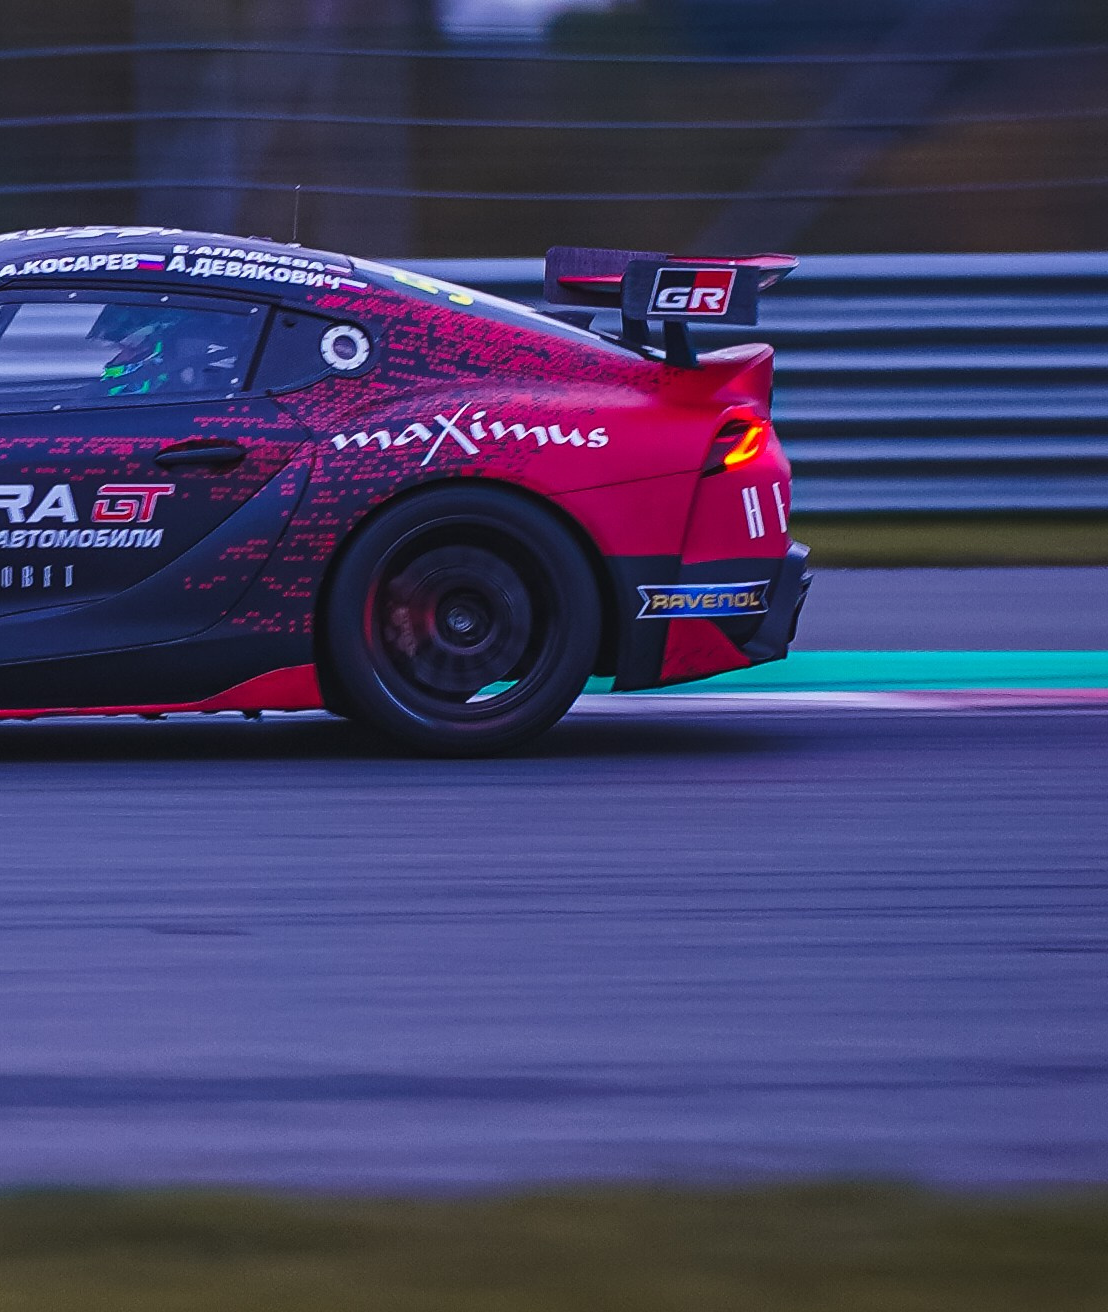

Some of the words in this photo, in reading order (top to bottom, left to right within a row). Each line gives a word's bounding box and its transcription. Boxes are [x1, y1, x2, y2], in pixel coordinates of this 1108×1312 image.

[165, 255, 342, 290] А.ДЕВЯКОВИЧ
[655, 287, 728, 311] GR
[91, 483, 177, 524] GT
[652, 592, 762, 610] RAVENOL
